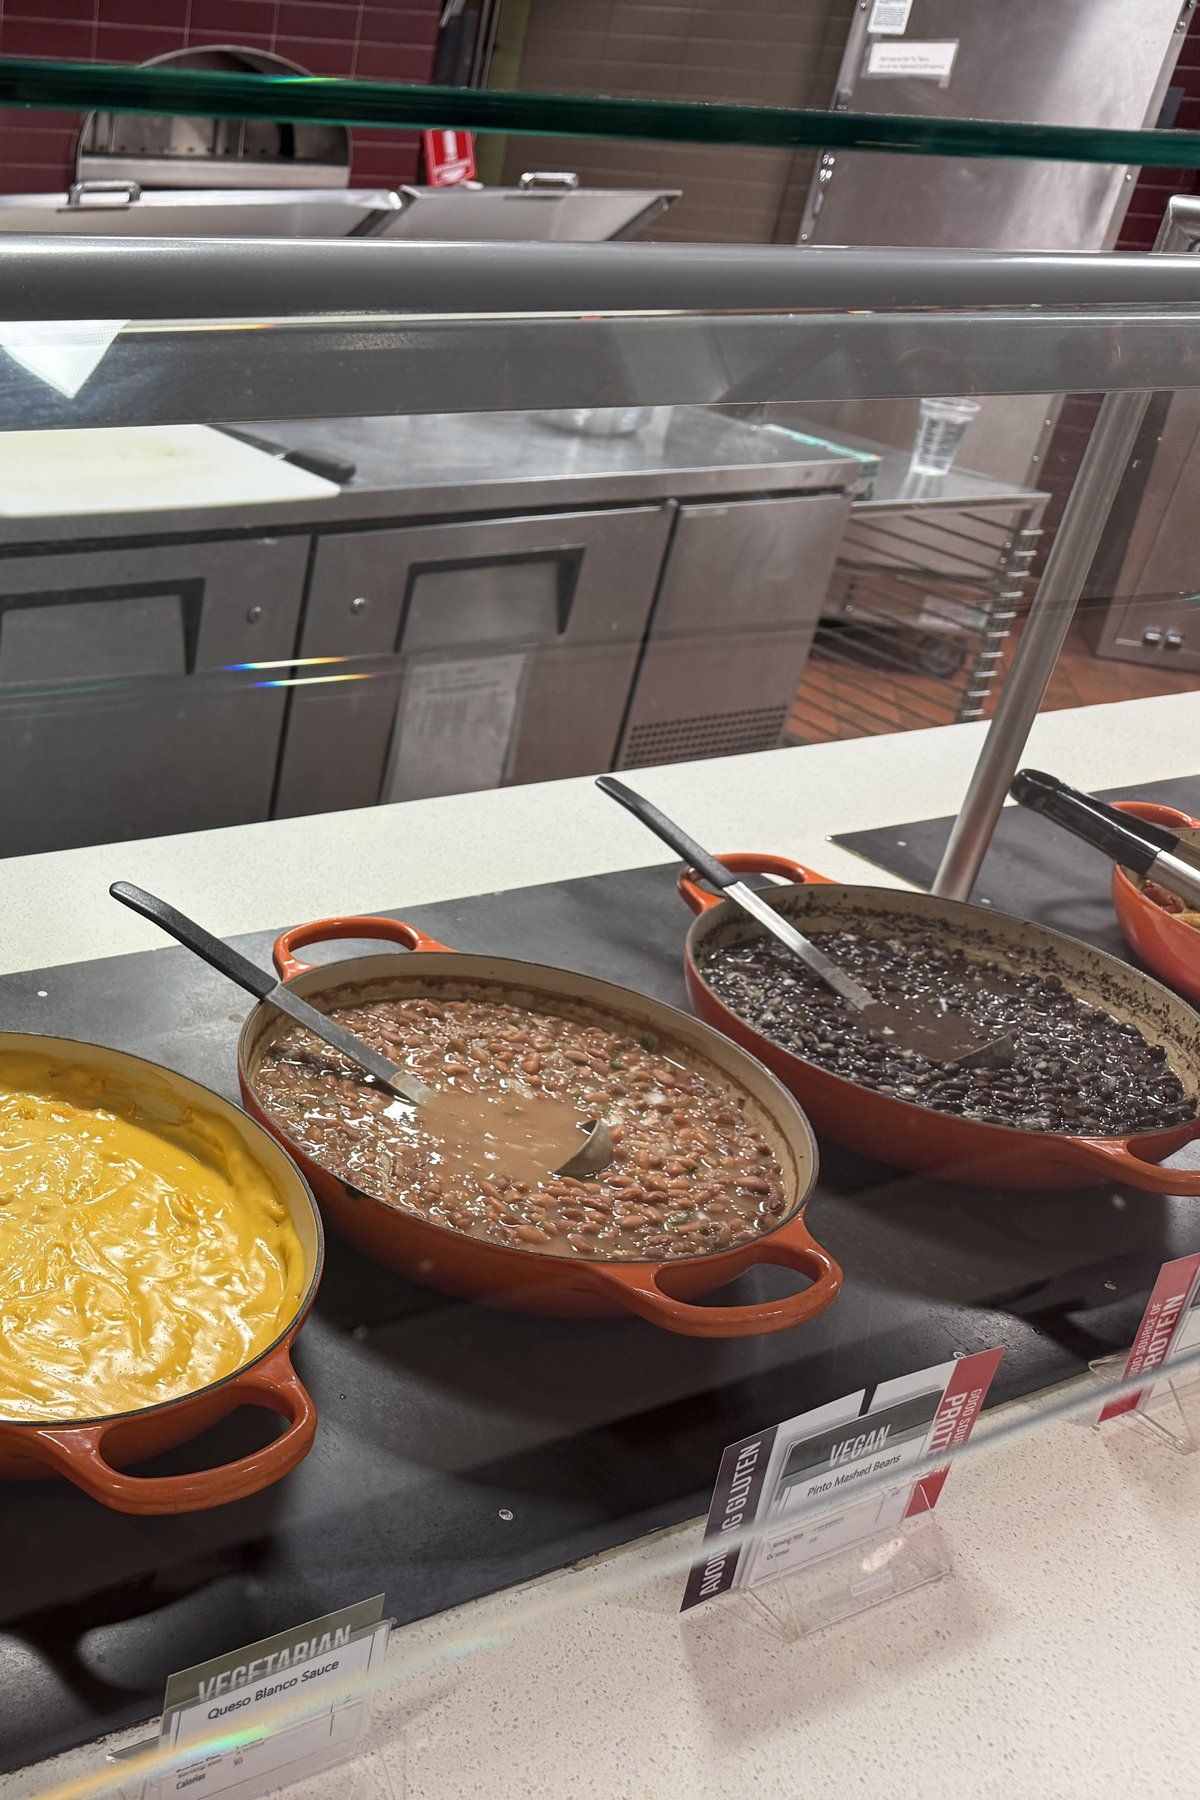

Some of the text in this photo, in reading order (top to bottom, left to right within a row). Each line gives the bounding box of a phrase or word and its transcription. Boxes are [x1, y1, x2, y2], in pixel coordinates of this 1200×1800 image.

[1136, 1318, 1157, 1356] SOURCE
[1150, 1302, 1163, 1318] OF
[962, 1387, 983, 1418] GOOD
[829, 1423, 892, 1468] VEGAN
[725, 1440, 762, 1515] GLUTEN
[807, 1454, 902, 1498] Pinto Mashed Beans
[198, 1624, 352, 1699] VEGETARIAN
[207, 1660, 340, 1720] Queso Blanco Sauce
